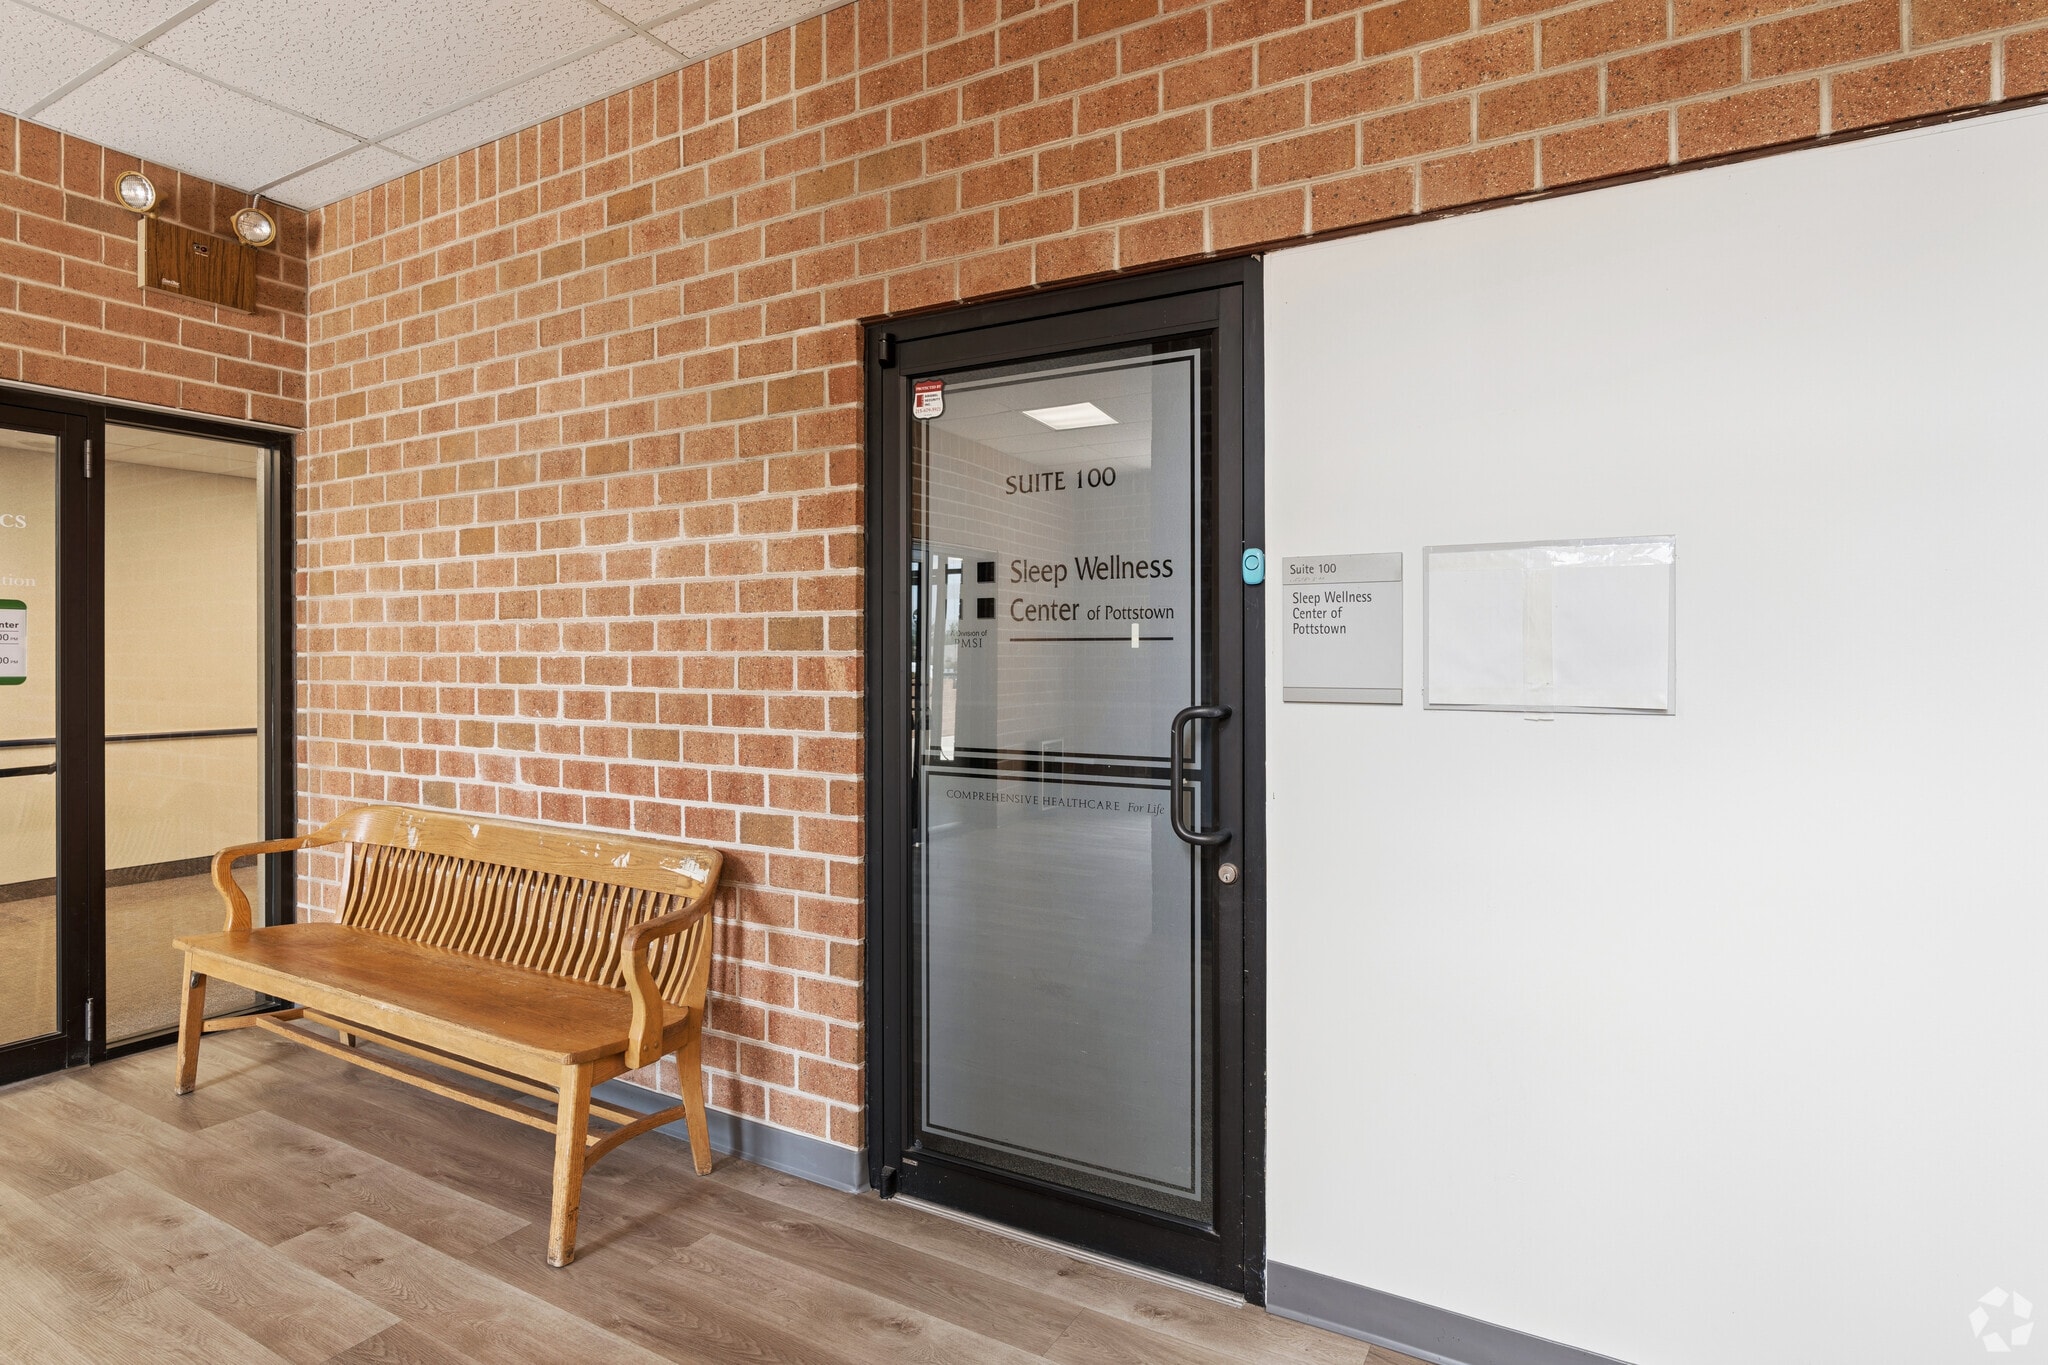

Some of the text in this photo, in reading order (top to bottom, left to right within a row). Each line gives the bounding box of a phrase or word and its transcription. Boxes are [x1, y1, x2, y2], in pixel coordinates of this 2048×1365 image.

[1005, 466, 1116, 494] SUITE 100
[1010, 554, 1174, 588] Sleep Wellness
[1290, 563, 1336, 574] Suite 100
[1292, 591, 1372, 606] Sleep Wellness
[1010, 598, 1174, 622] Center of Pottstown
[1292, 606, 1343, 619] Center of
[1293, 623, 1346, 634] Pottstown
[946, 790, 1165, 815] COMPREHENSIVE HEALTHCARE For Life
